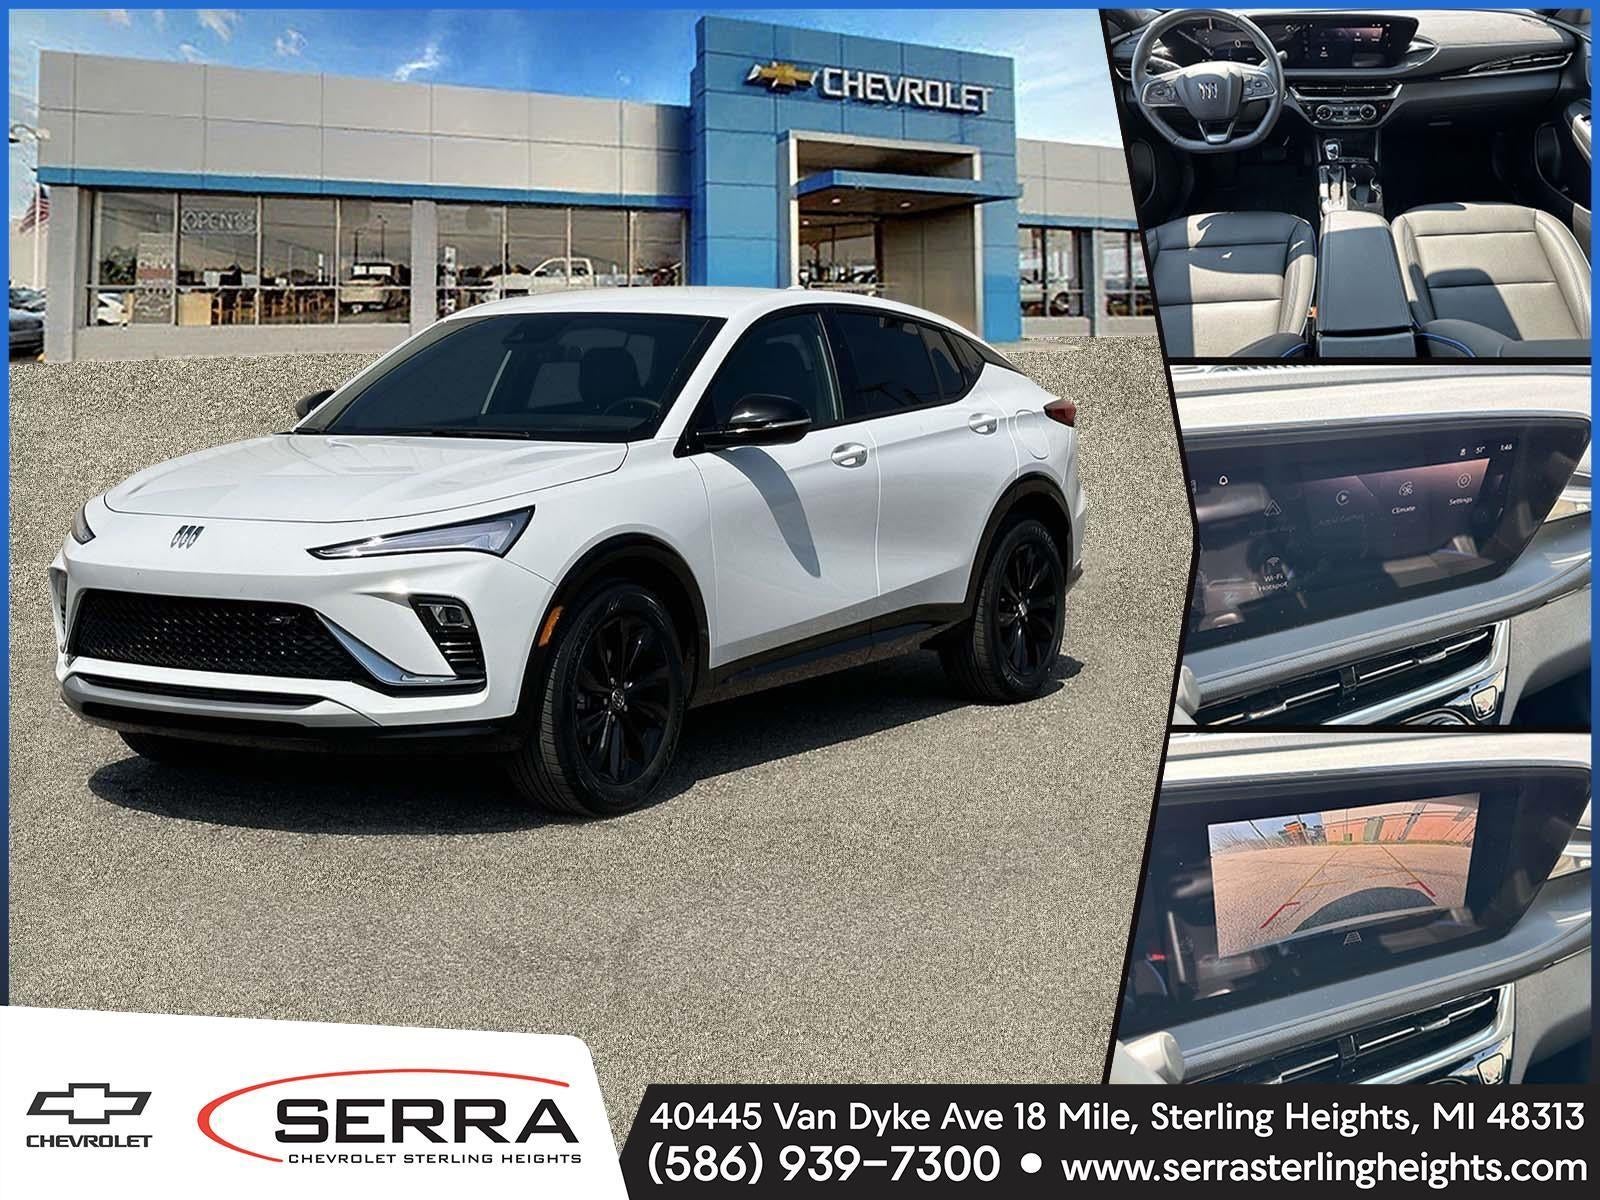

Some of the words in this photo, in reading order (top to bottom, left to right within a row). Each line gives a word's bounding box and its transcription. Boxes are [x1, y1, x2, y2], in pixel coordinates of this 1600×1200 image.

[823, 66, 994, 113] CHEVROLET
[1391, 505, 1416, 515] Climate
[1258, 581, 1288, 592] Hotspot
